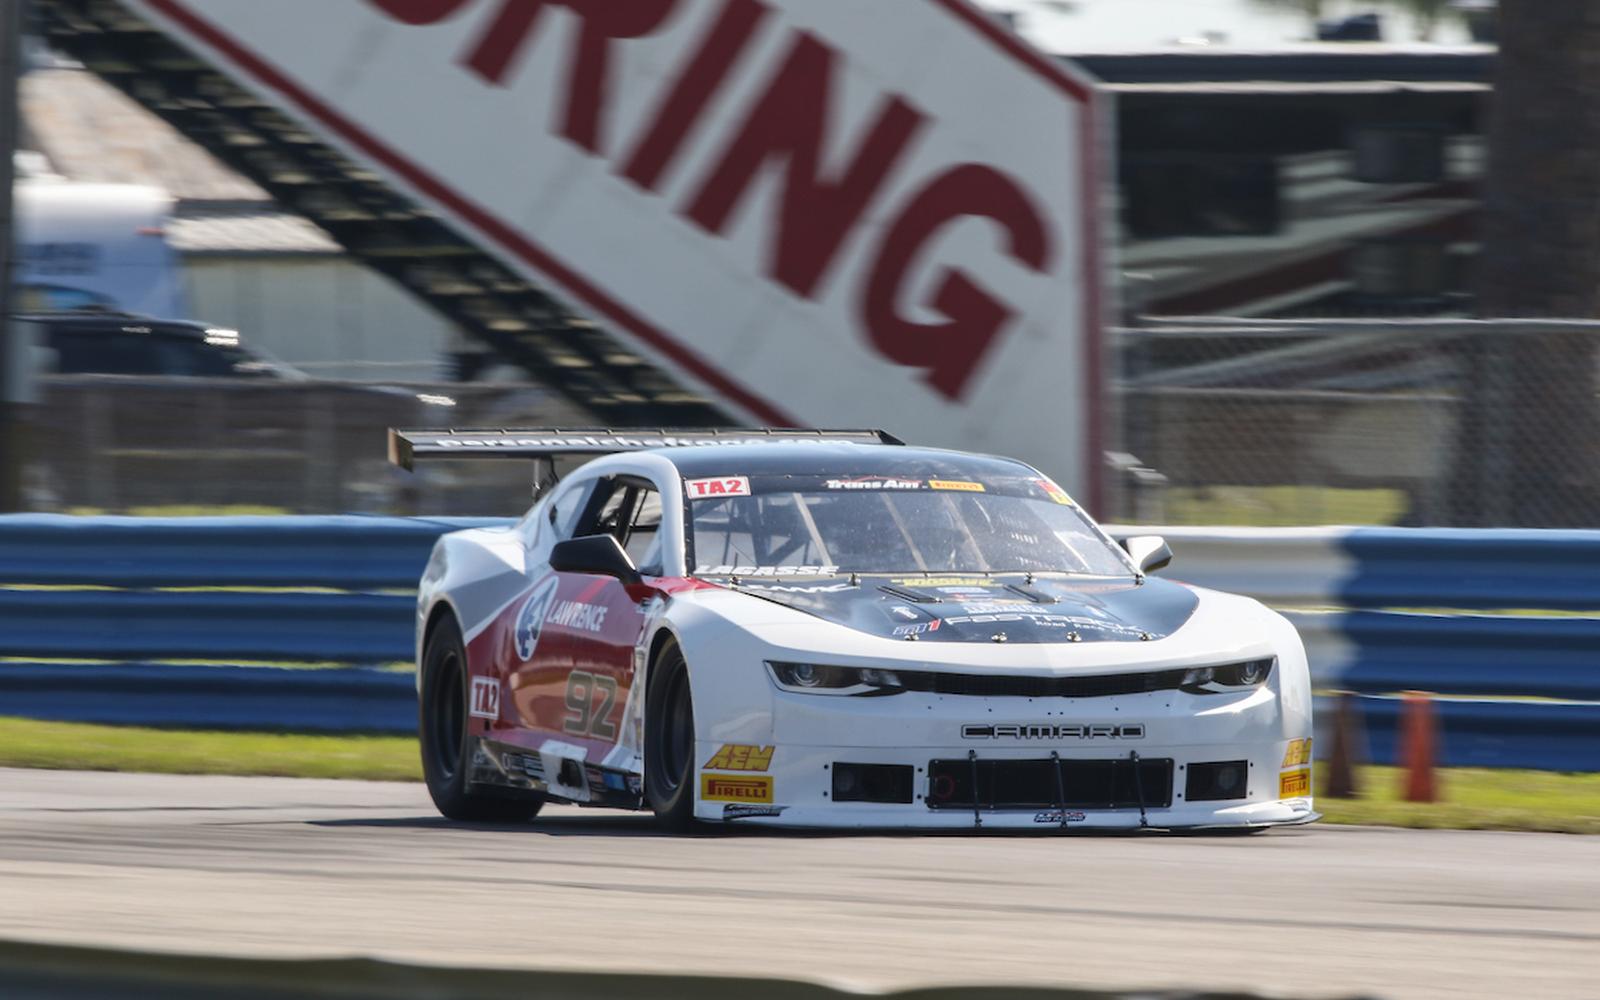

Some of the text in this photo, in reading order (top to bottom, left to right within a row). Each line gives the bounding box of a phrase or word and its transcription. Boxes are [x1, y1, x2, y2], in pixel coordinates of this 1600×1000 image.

[362, 0, 1058, 405] RING
[693, 480, 743, 494] TA2
[826, 479, 921, 489] Trans Am
[693, 565, 840, 576] LACASSE
[546, 598, 608, 632] LAWRENCE
[475, 682, 497, 713] TA2
[563, 670, 617, 742] 92
[961, 724, 1145, 740] CAMARO
[702, 743, 776, 772] AEM
[708, 779, 768, 798] PIRELLI
